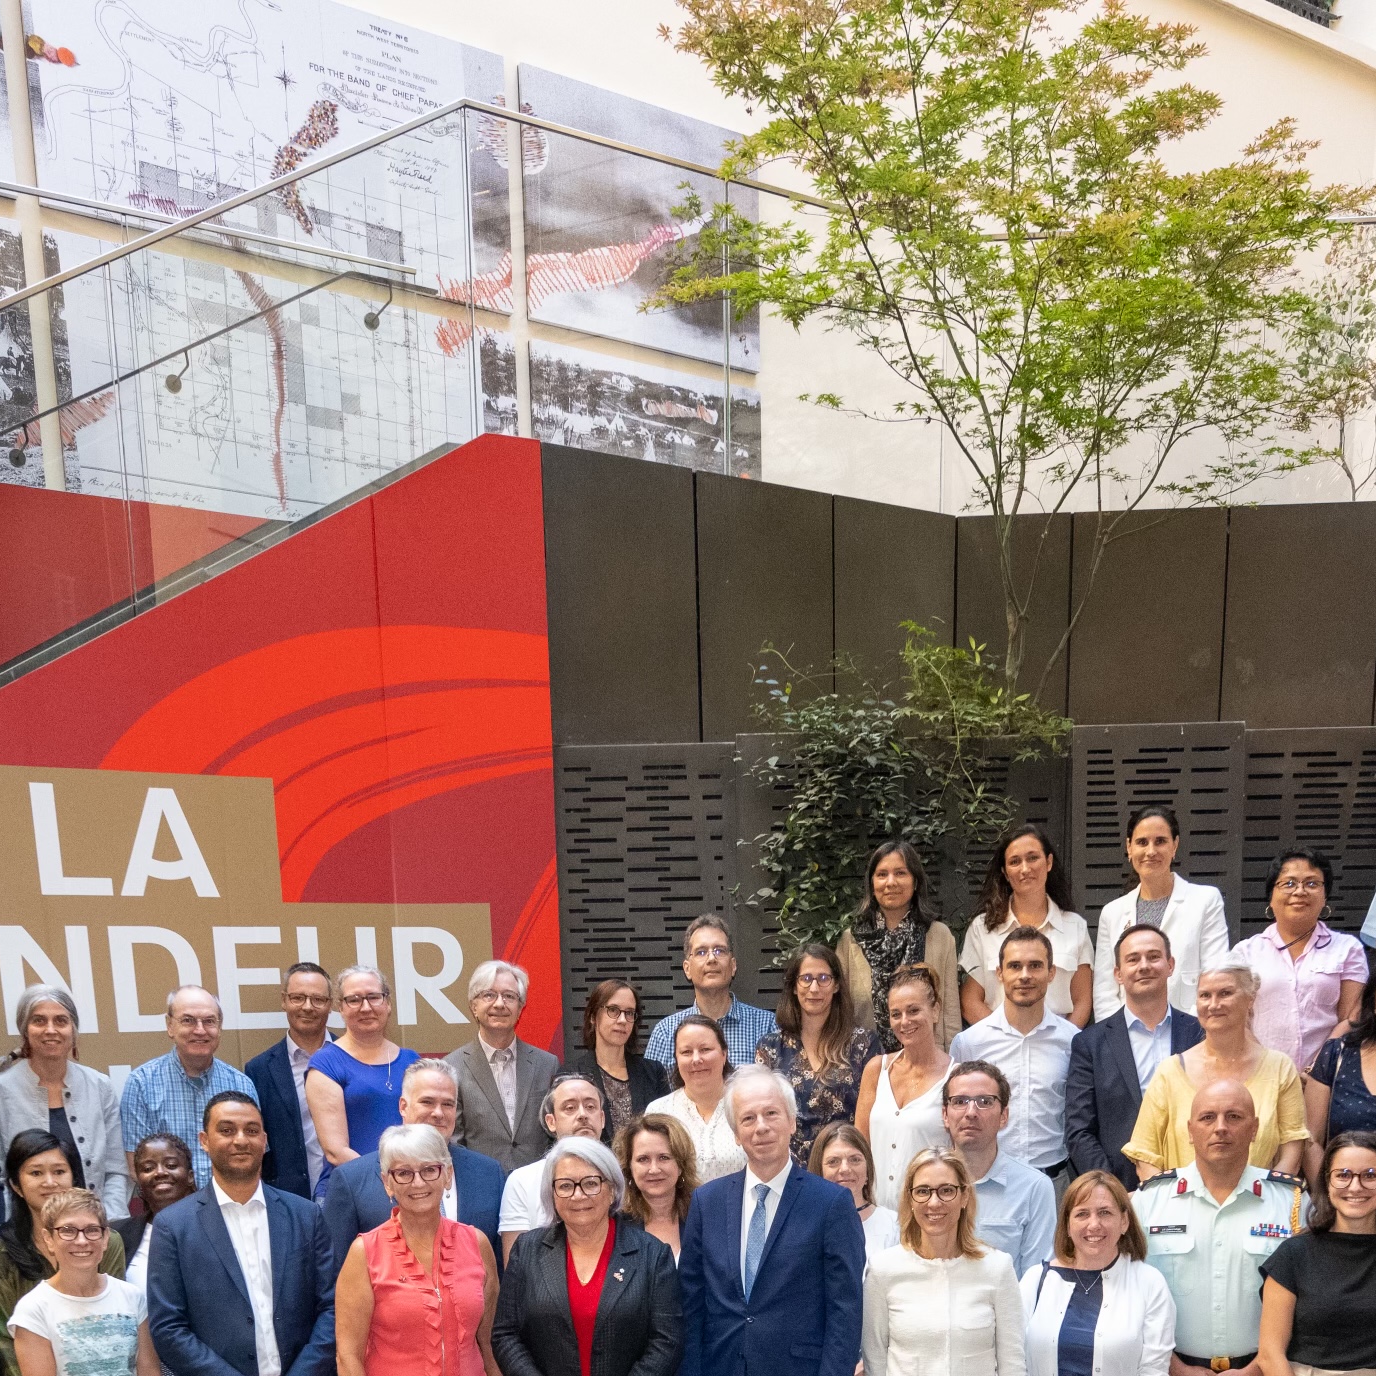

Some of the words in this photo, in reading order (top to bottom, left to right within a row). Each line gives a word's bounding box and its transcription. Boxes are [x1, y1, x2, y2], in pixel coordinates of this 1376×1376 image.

[381, 51, 402, 63] PLAN
[309, 62, 326, 75] FOR
[327, 68, 345, 80] THE
[347, 74, 371, 88] BAND
[375, 83, 387, 92] OF
[392, 88, 415, 101] CHIEF
[29, 782, 221, 897] LA
